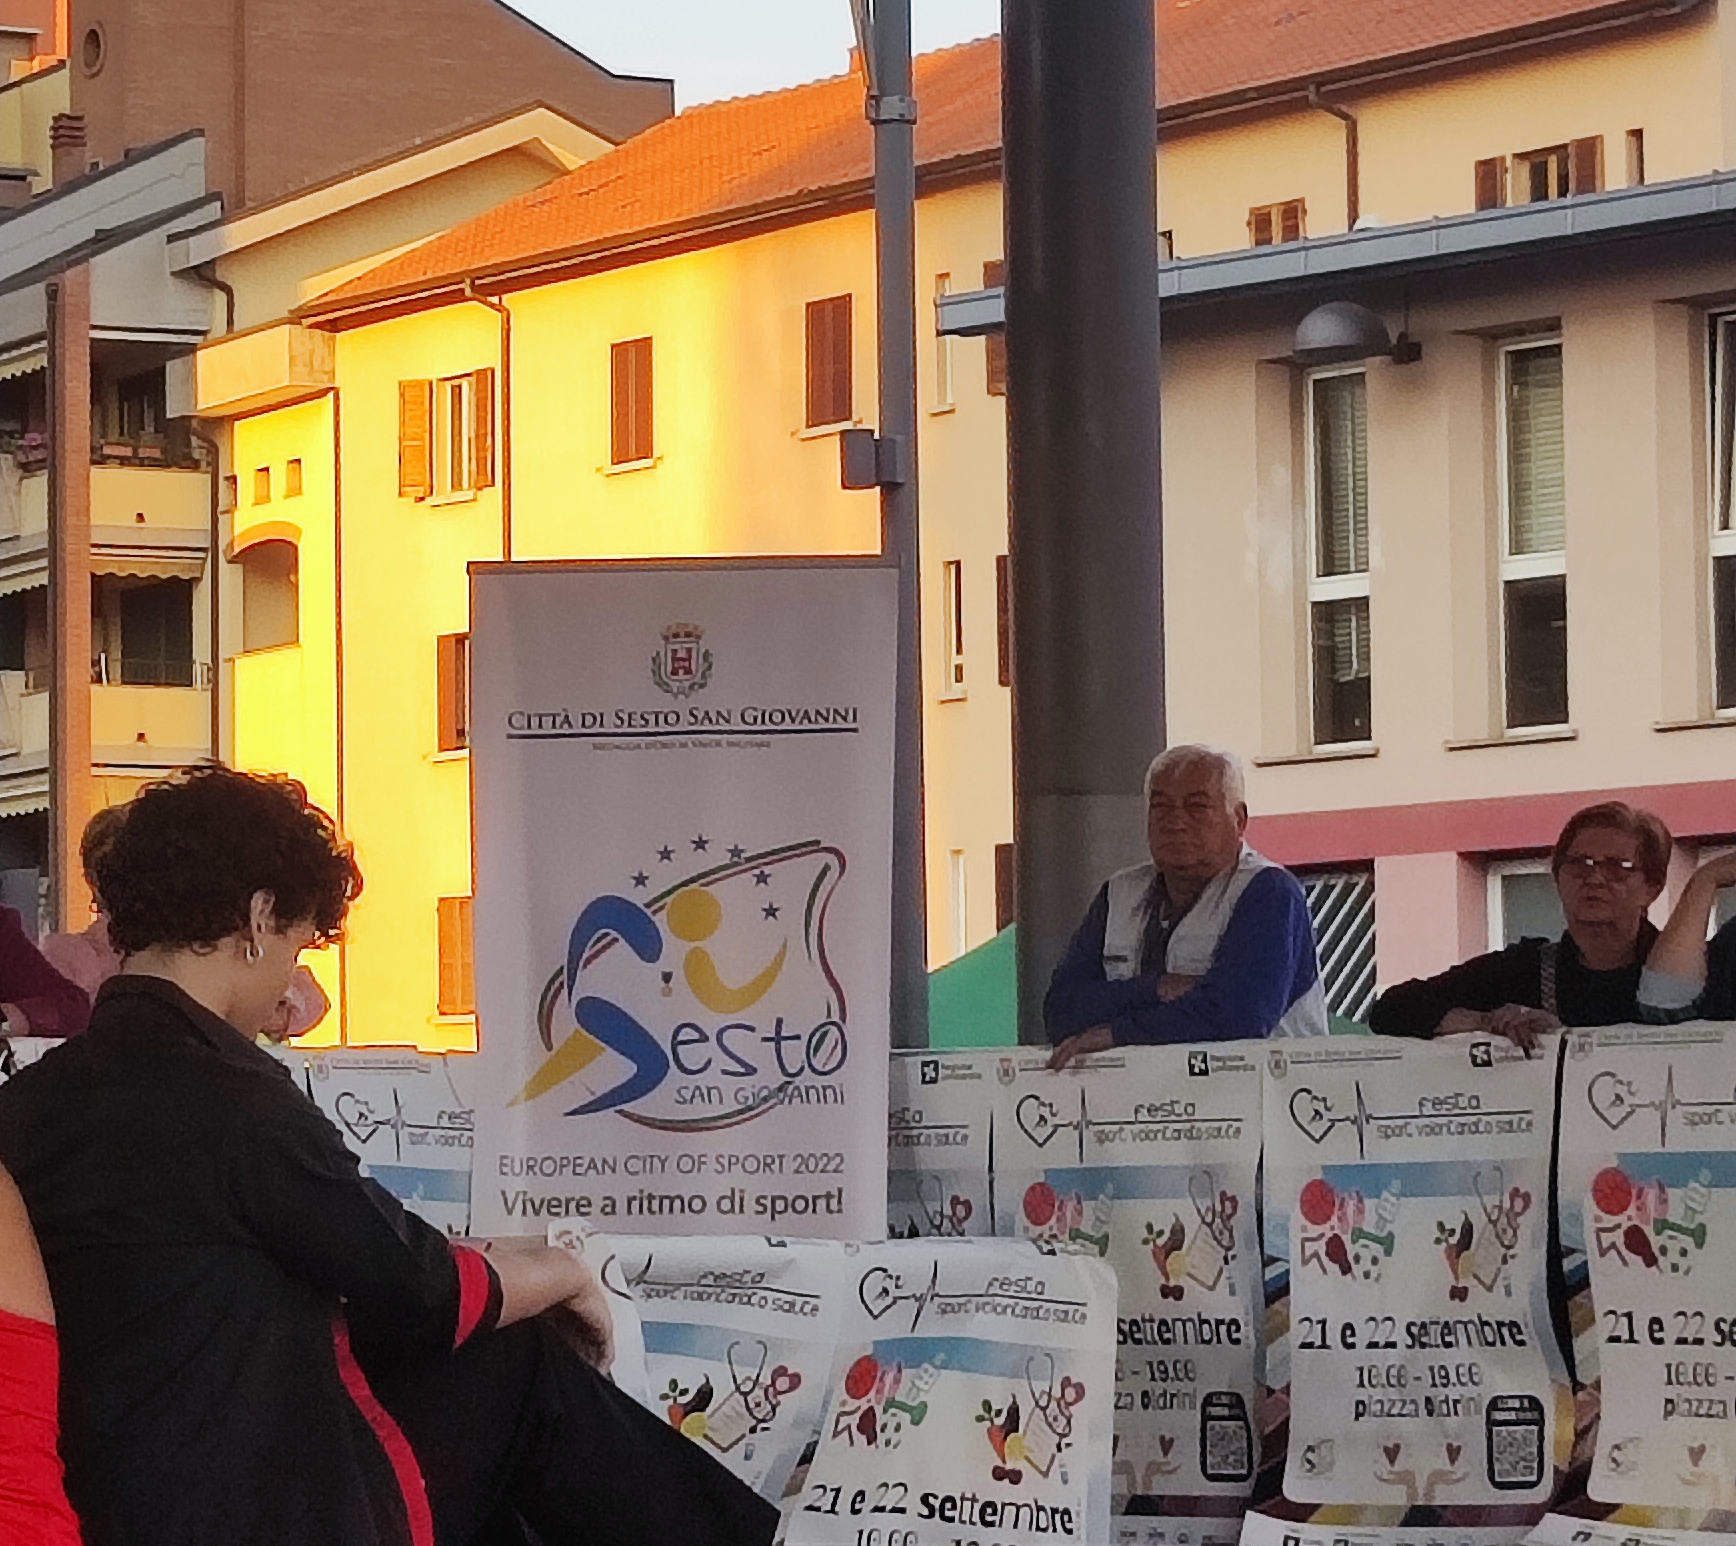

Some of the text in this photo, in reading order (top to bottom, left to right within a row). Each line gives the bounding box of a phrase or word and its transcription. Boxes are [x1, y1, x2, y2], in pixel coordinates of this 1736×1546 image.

[507, 705, 858, 730] CITTÀ DI SESTO SAN GIOVANNI
[498, 1153, 844, 1177] EUROPEAN CITY OF SPORT 2022
[500, 1187, 843, 1222] Vivere a ritmo di sport!
[1116, 1311, 1241, 1346] settembre
[1298, 1313, 1527, 1350] 21 e 22 settembre
[1603, 1309, 1640, 1345] 21
[1647, 1316, 1665, 1345] e
[1673, 1310, 1705, 1346] 22
[1354, 1394, 1420, 1422] piazza
[1663, 1394, 1728, 1422] piazza
[803, 1484, 842, 1516] 21
[849, 1489, 866, 1515] e
[870, 1482, 909, 1515] 22
[917, 1491, 1074, 1536] settembre
